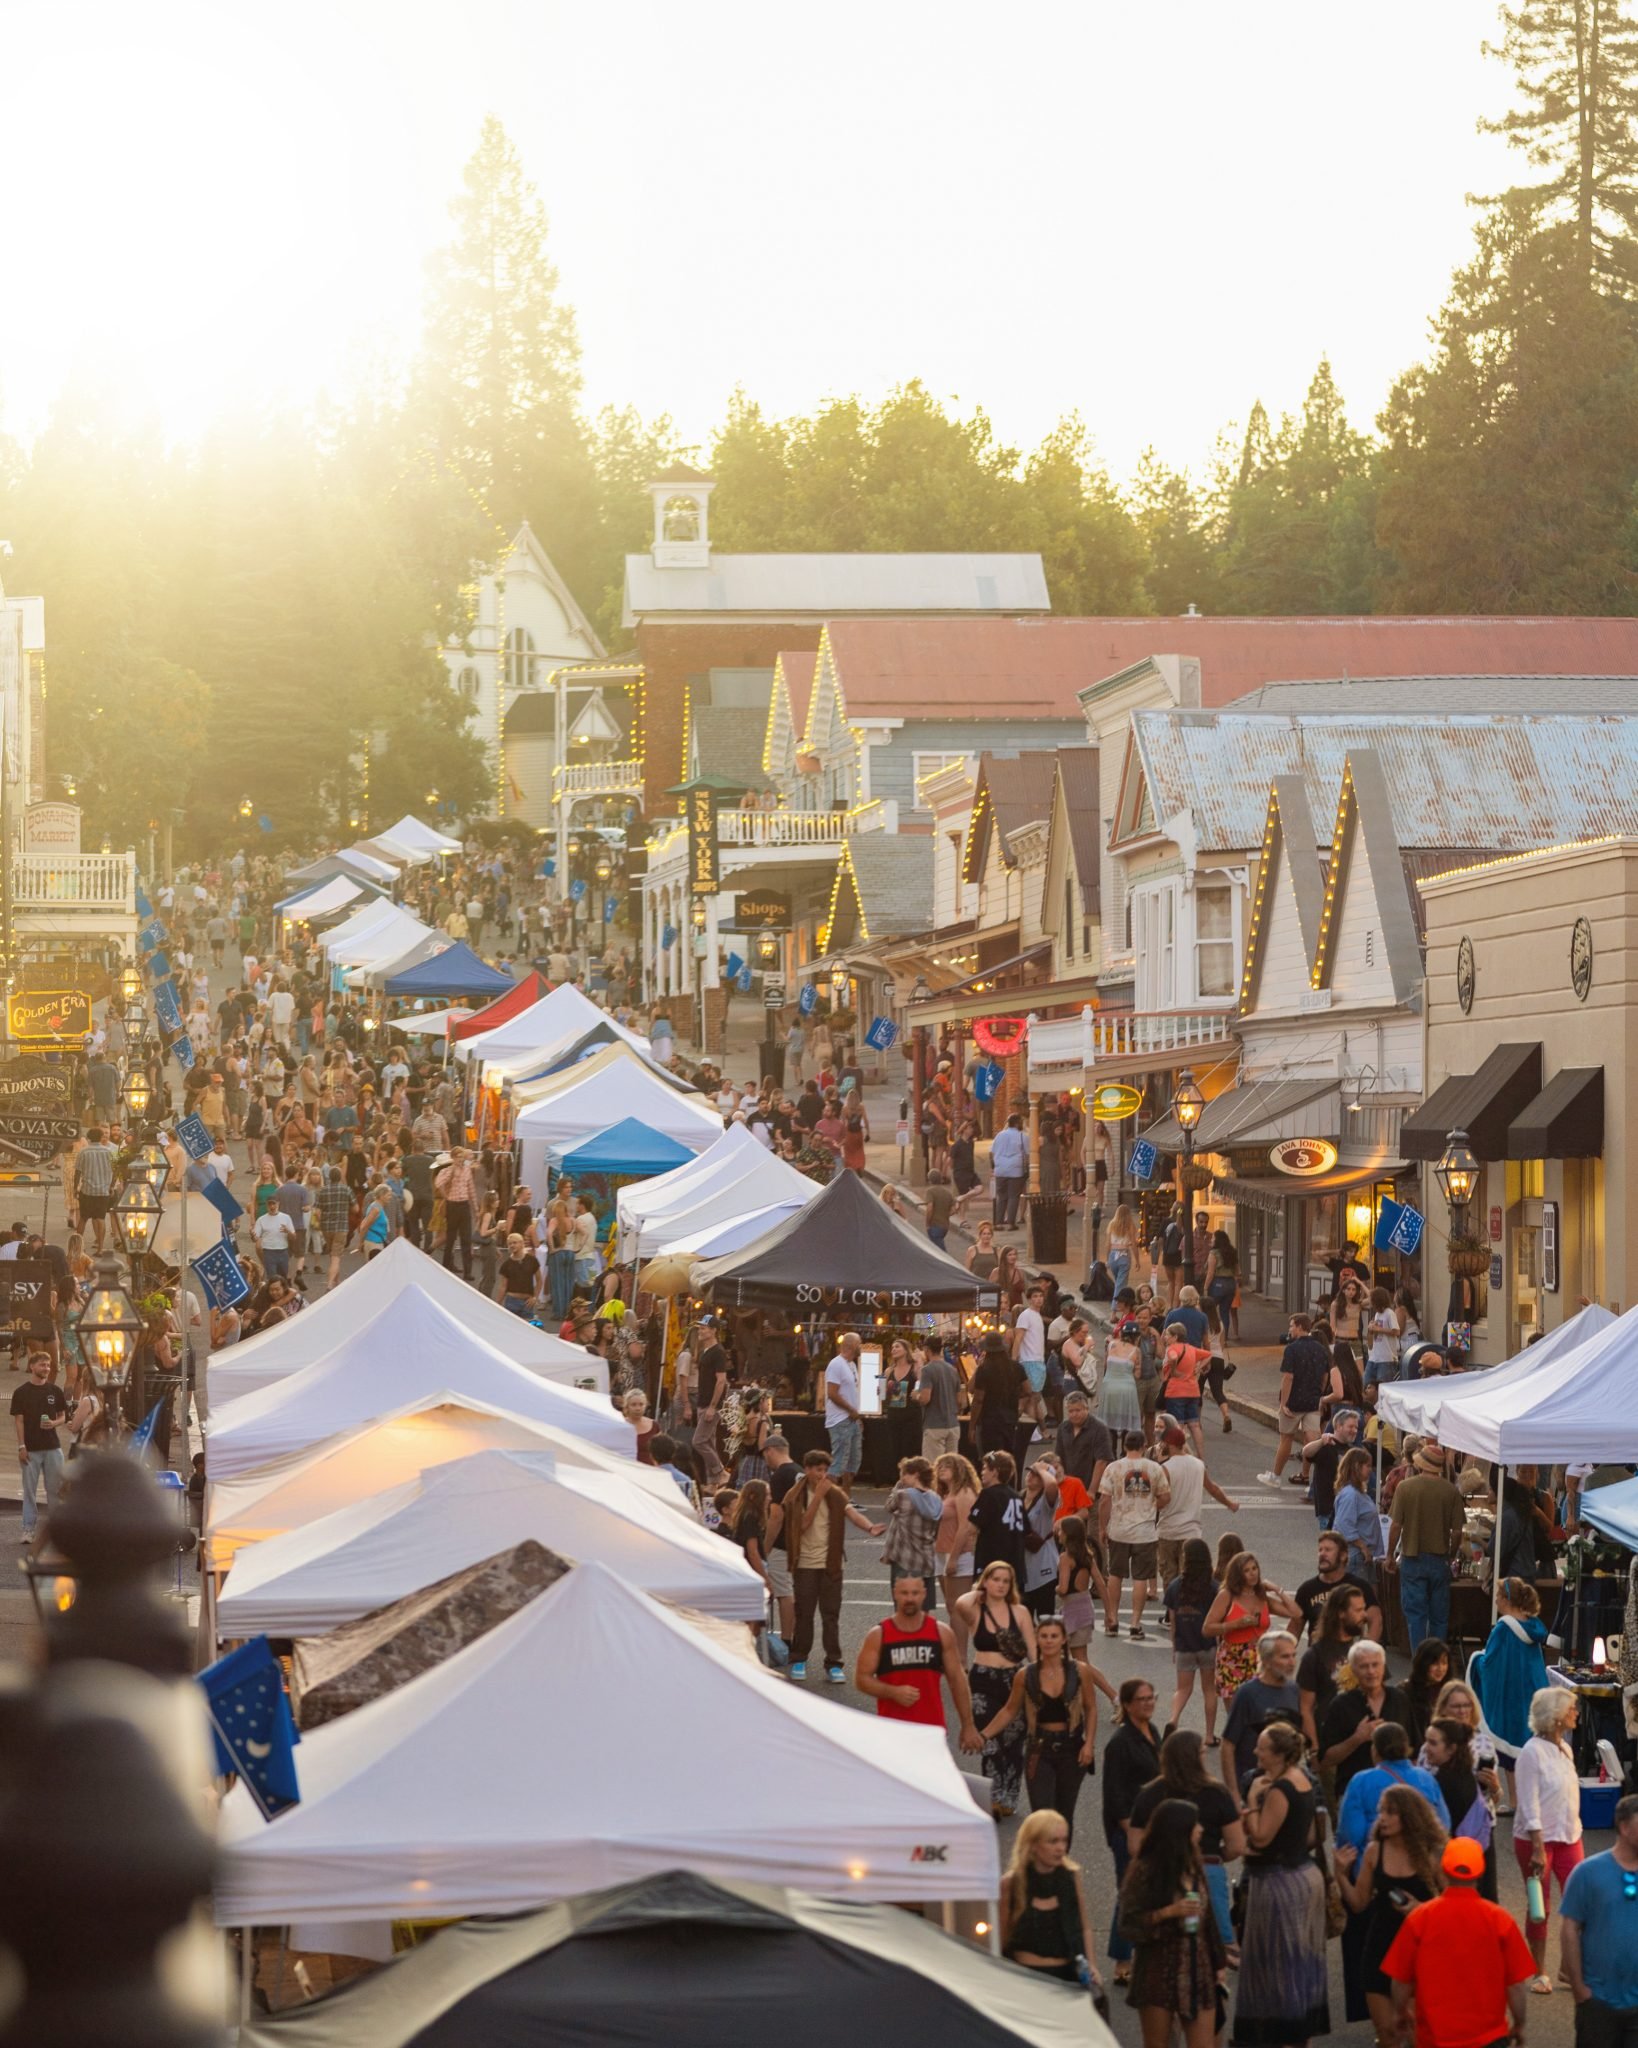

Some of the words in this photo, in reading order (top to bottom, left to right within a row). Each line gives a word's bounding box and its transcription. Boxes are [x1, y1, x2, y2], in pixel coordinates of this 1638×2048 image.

[693, 800, 713, 833] NEW
[31, 831, 76, 843] MARKET
[695, 837, 712, 880] YORK
[740, 902, 786, 917] Shops
[61, 996, 87, 1017] ERA
[15, 1140, 55, 1151] MEN'S
[1276, 1141, 1297, 1156] JAVA
